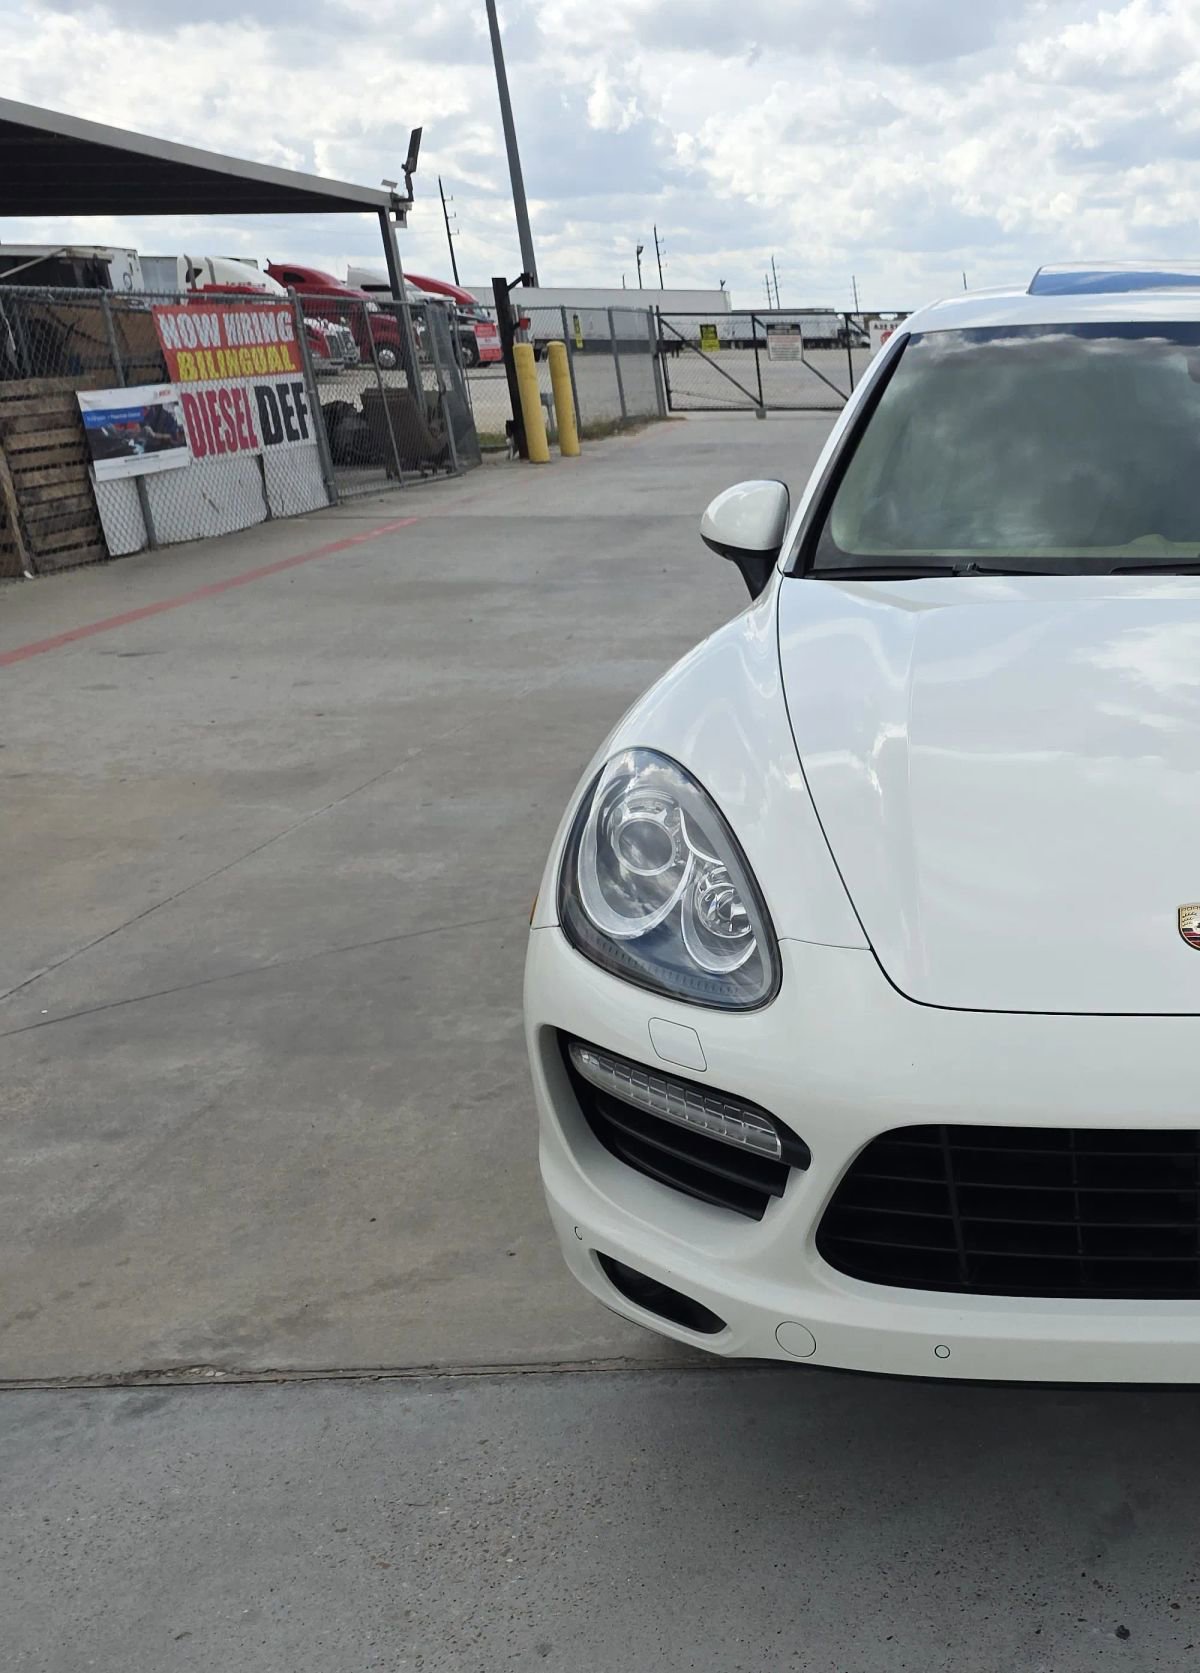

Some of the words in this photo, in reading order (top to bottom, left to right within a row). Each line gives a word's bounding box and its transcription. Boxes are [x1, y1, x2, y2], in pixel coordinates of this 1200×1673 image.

[158, 312, 221, 349] NOW
[223, 310, 294, 346] HIRING
[176, 344, 296, 382] BILINGUAL
[180, 387, 259, 459] DIESEL
[253, 382, 310, 446] DEF
